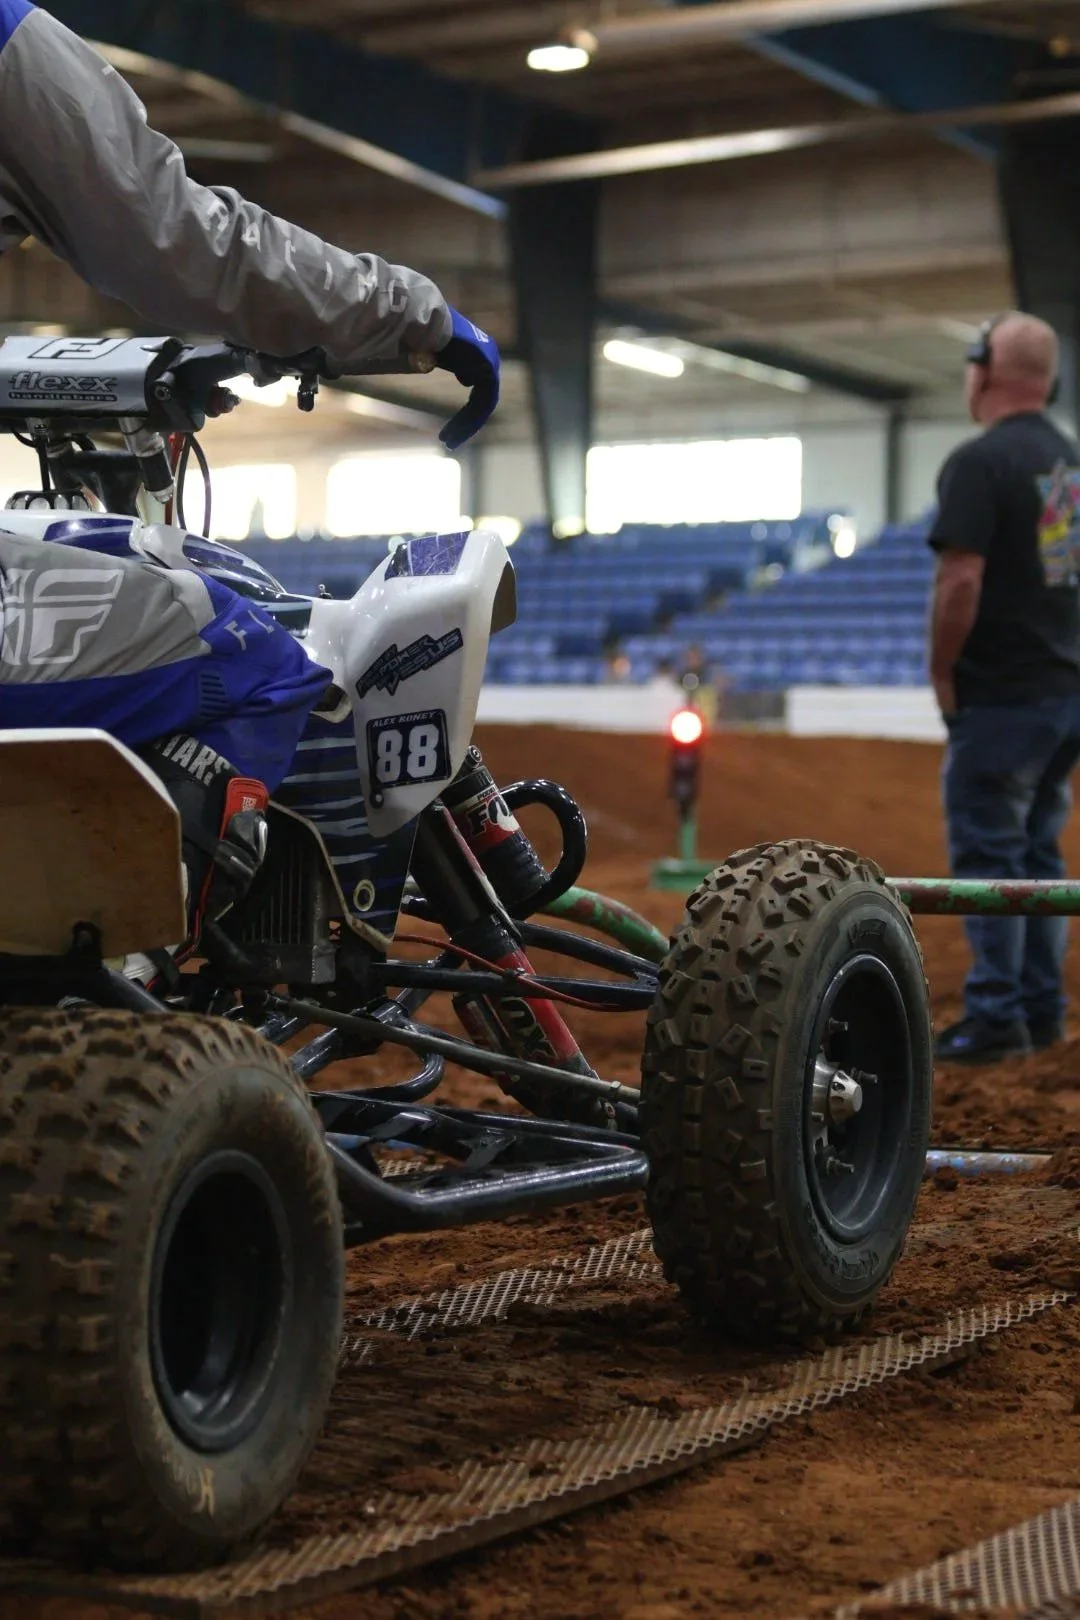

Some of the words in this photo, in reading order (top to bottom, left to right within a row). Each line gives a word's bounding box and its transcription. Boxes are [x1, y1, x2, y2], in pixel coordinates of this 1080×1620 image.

[9, 371, 116, 391] flexx
[372, 717, 396, 728] ALEX
[376, 724, 440, 784] 88
